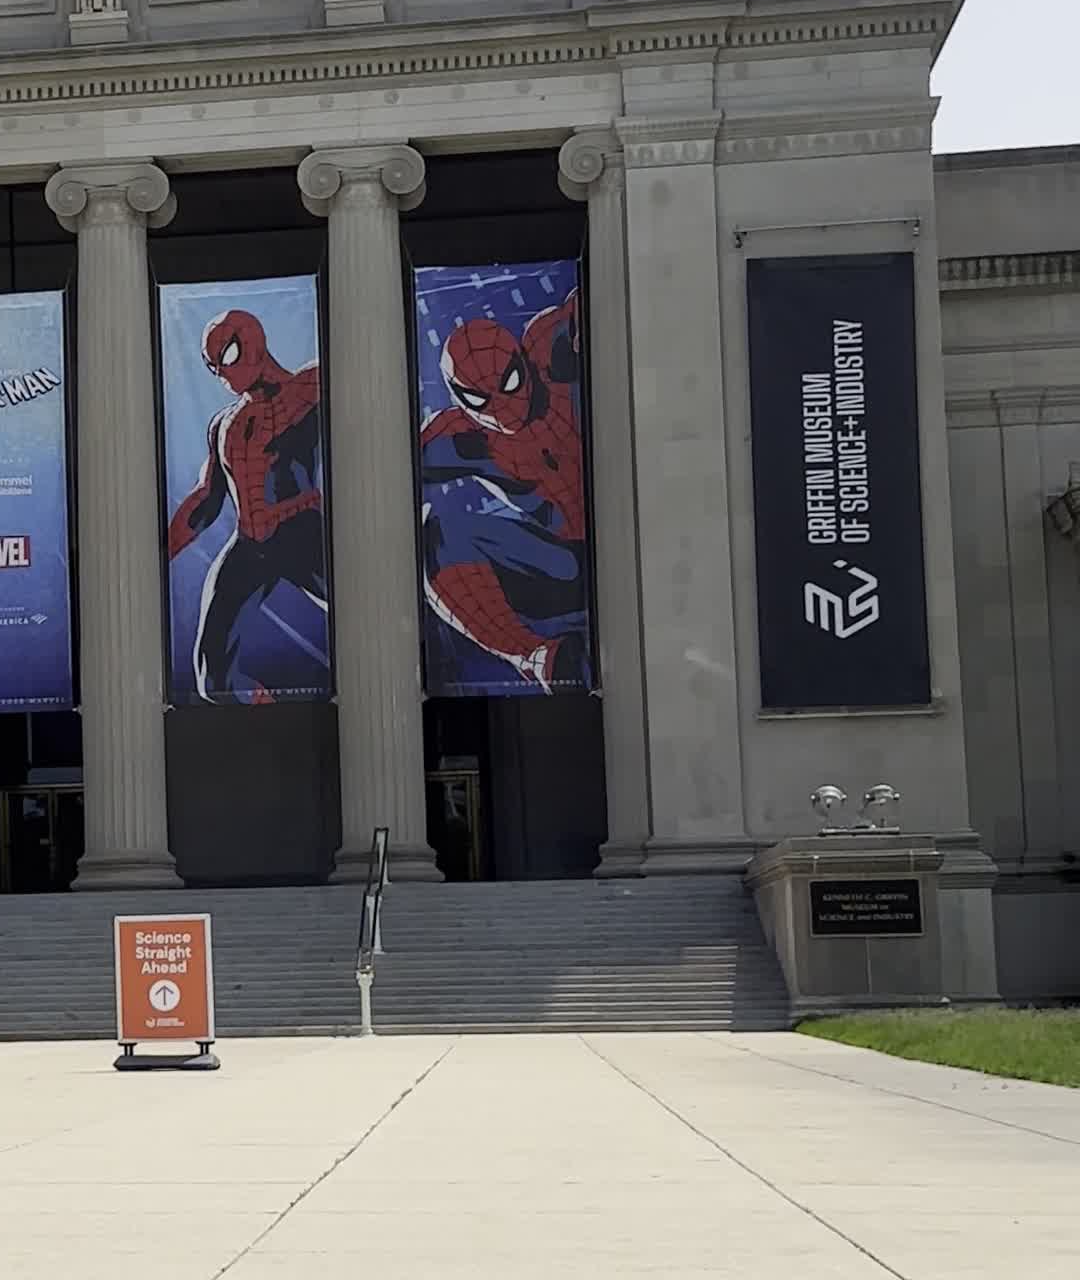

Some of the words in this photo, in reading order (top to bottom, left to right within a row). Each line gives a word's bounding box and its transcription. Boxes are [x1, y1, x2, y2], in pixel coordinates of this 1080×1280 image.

[802, 373, 834, 463] MUSEUM
[805, 469, 837, 544] GRIFFIN
[839, 518, 870, 543] OF
[135, 931, 192, 945] Science
[135, 946, 192, 962] Straight
[141, 962, 187, 974] Ahead
